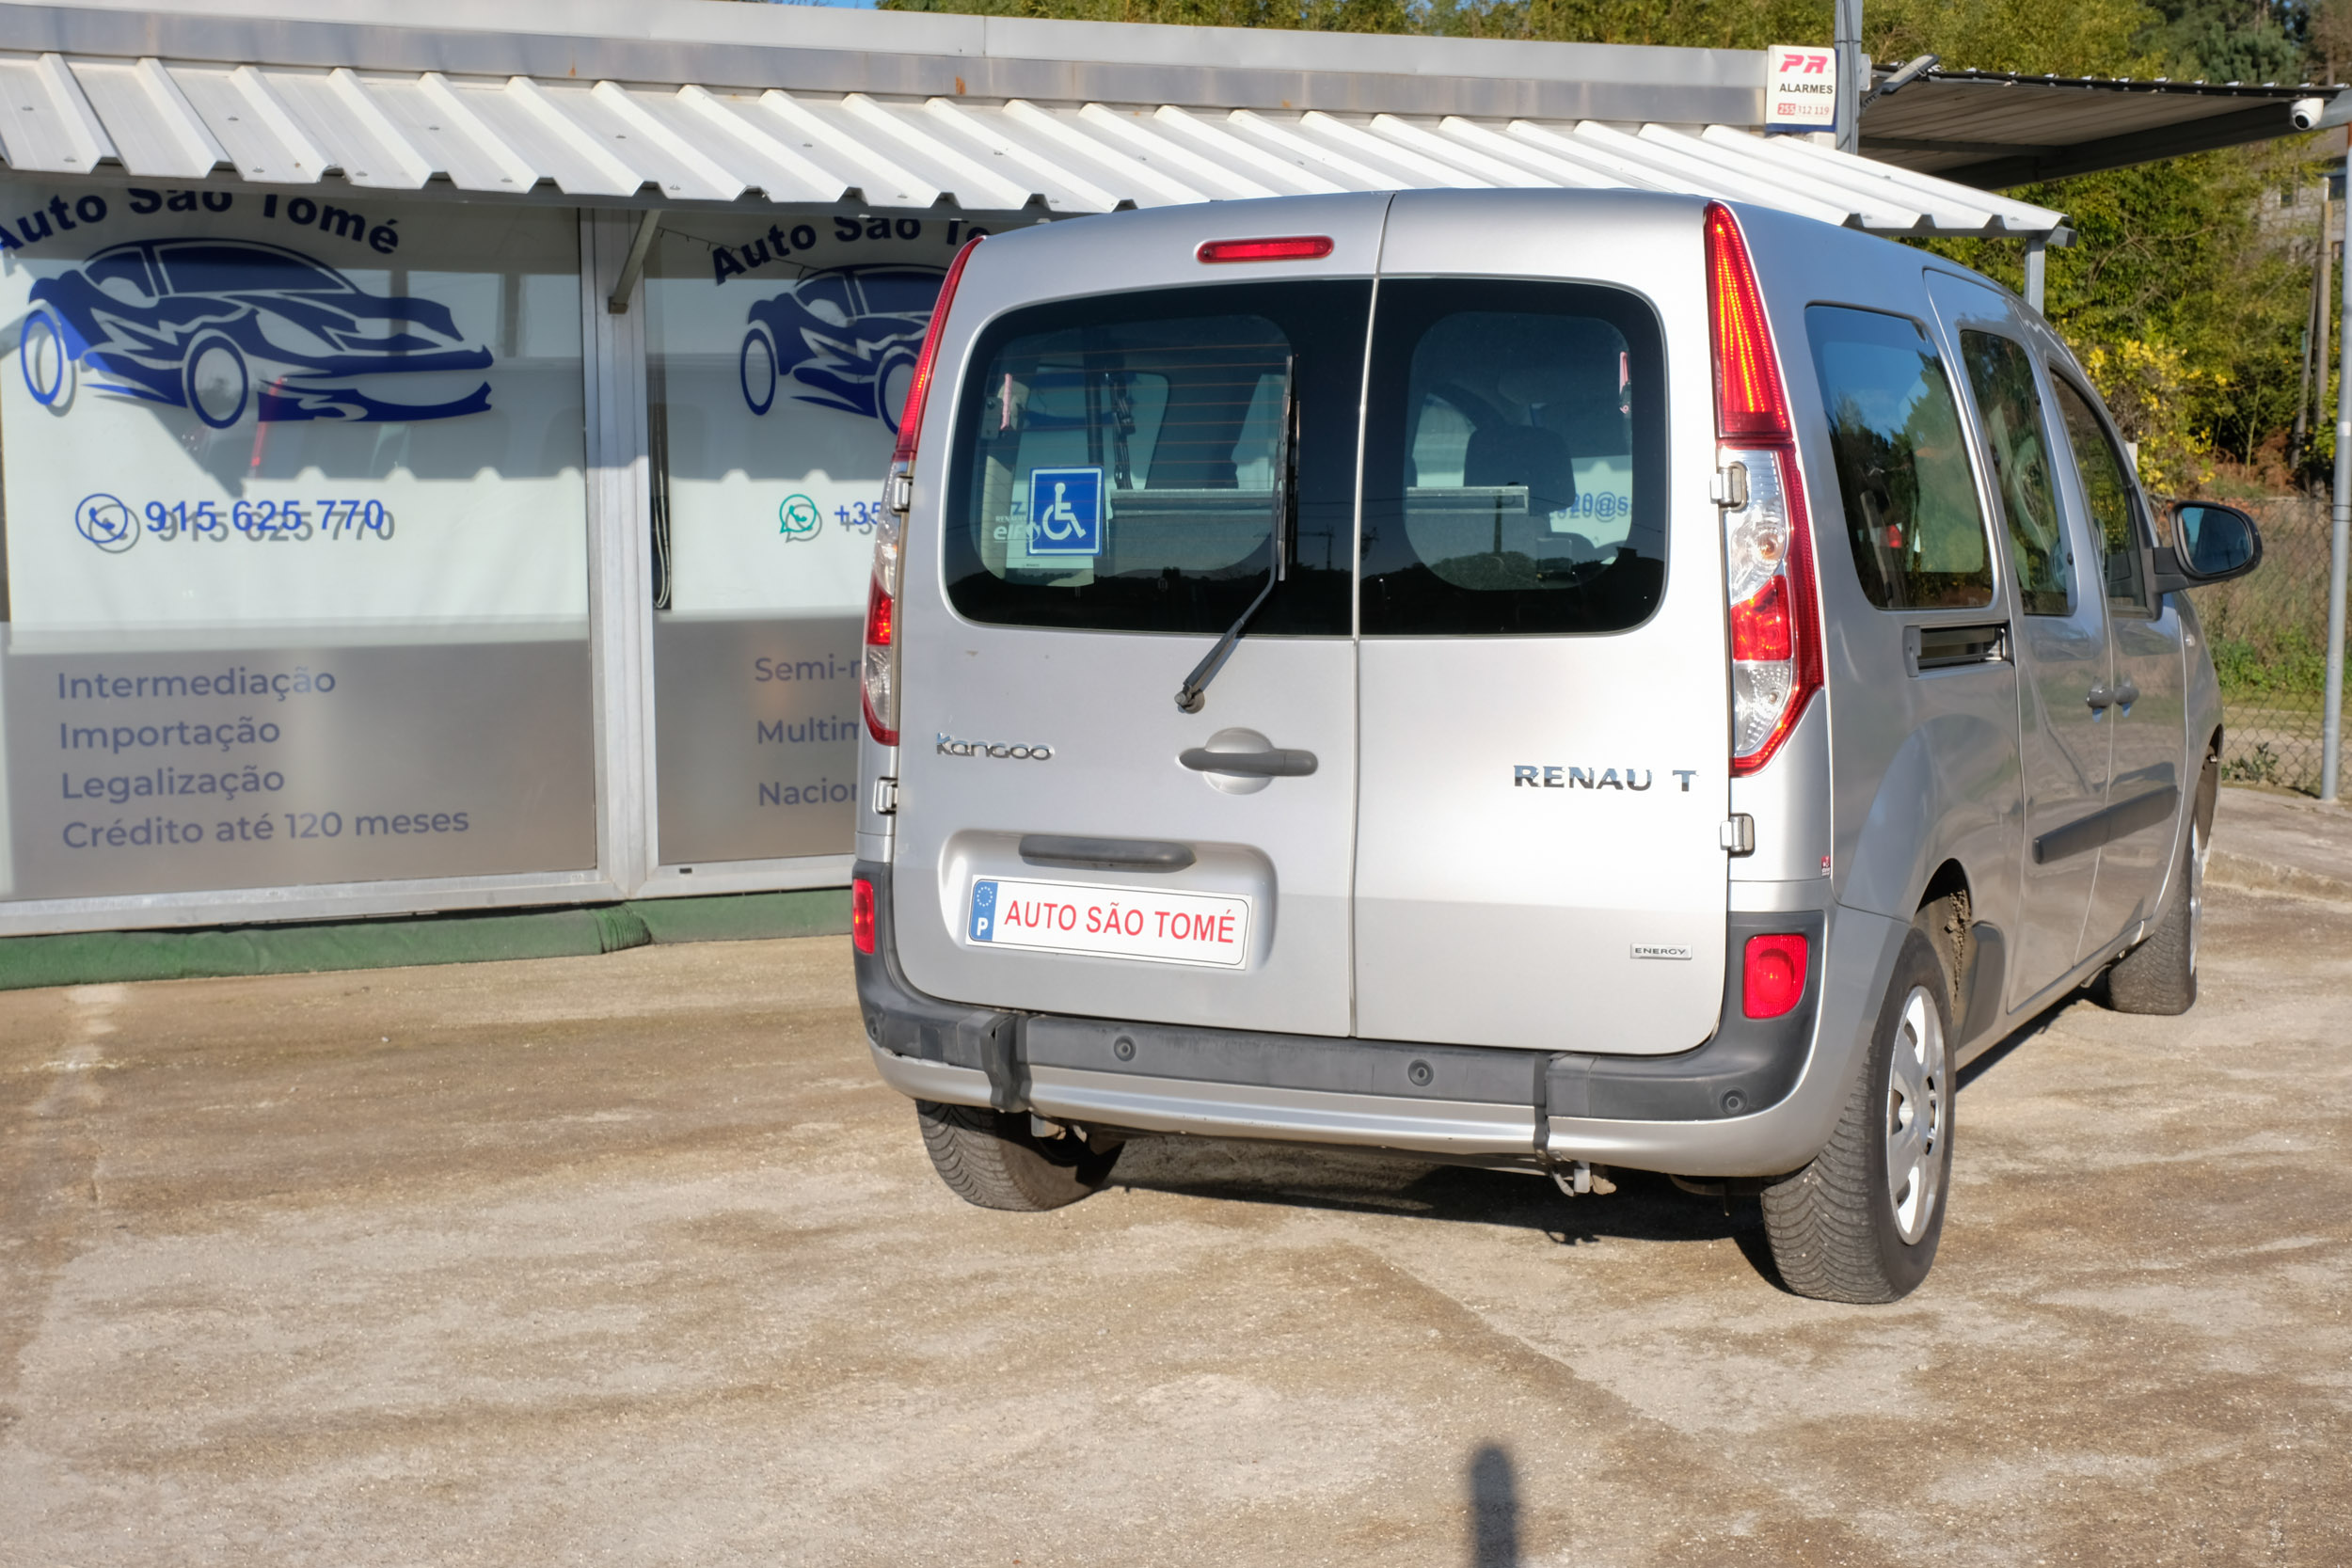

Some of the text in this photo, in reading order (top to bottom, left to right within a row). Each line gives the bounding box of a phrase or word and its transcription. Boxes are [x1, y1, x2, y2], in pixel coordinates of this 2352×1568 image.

[1779, 54, 1829, 73] PR
[1779, 83, 1834, 94] ALARMES
[1778, 103, 1795, 114] 255
[1814, 106, 1830, 115] 119
[711, 223, 817, 286] Auto
[145, 499, 384, 532] 915 625 770
[57, 666, 336, 702] Intermediação
[60, 715, 281, 753] Importação
[62, 764, 285, 803] Legalização
[62, 811, 469, 847] Crédito até 120 meses
[977, 900, 1236, 944] P AUTO SÃO TOMÉ
[1634, 947, 1687, 956] ENERGY
